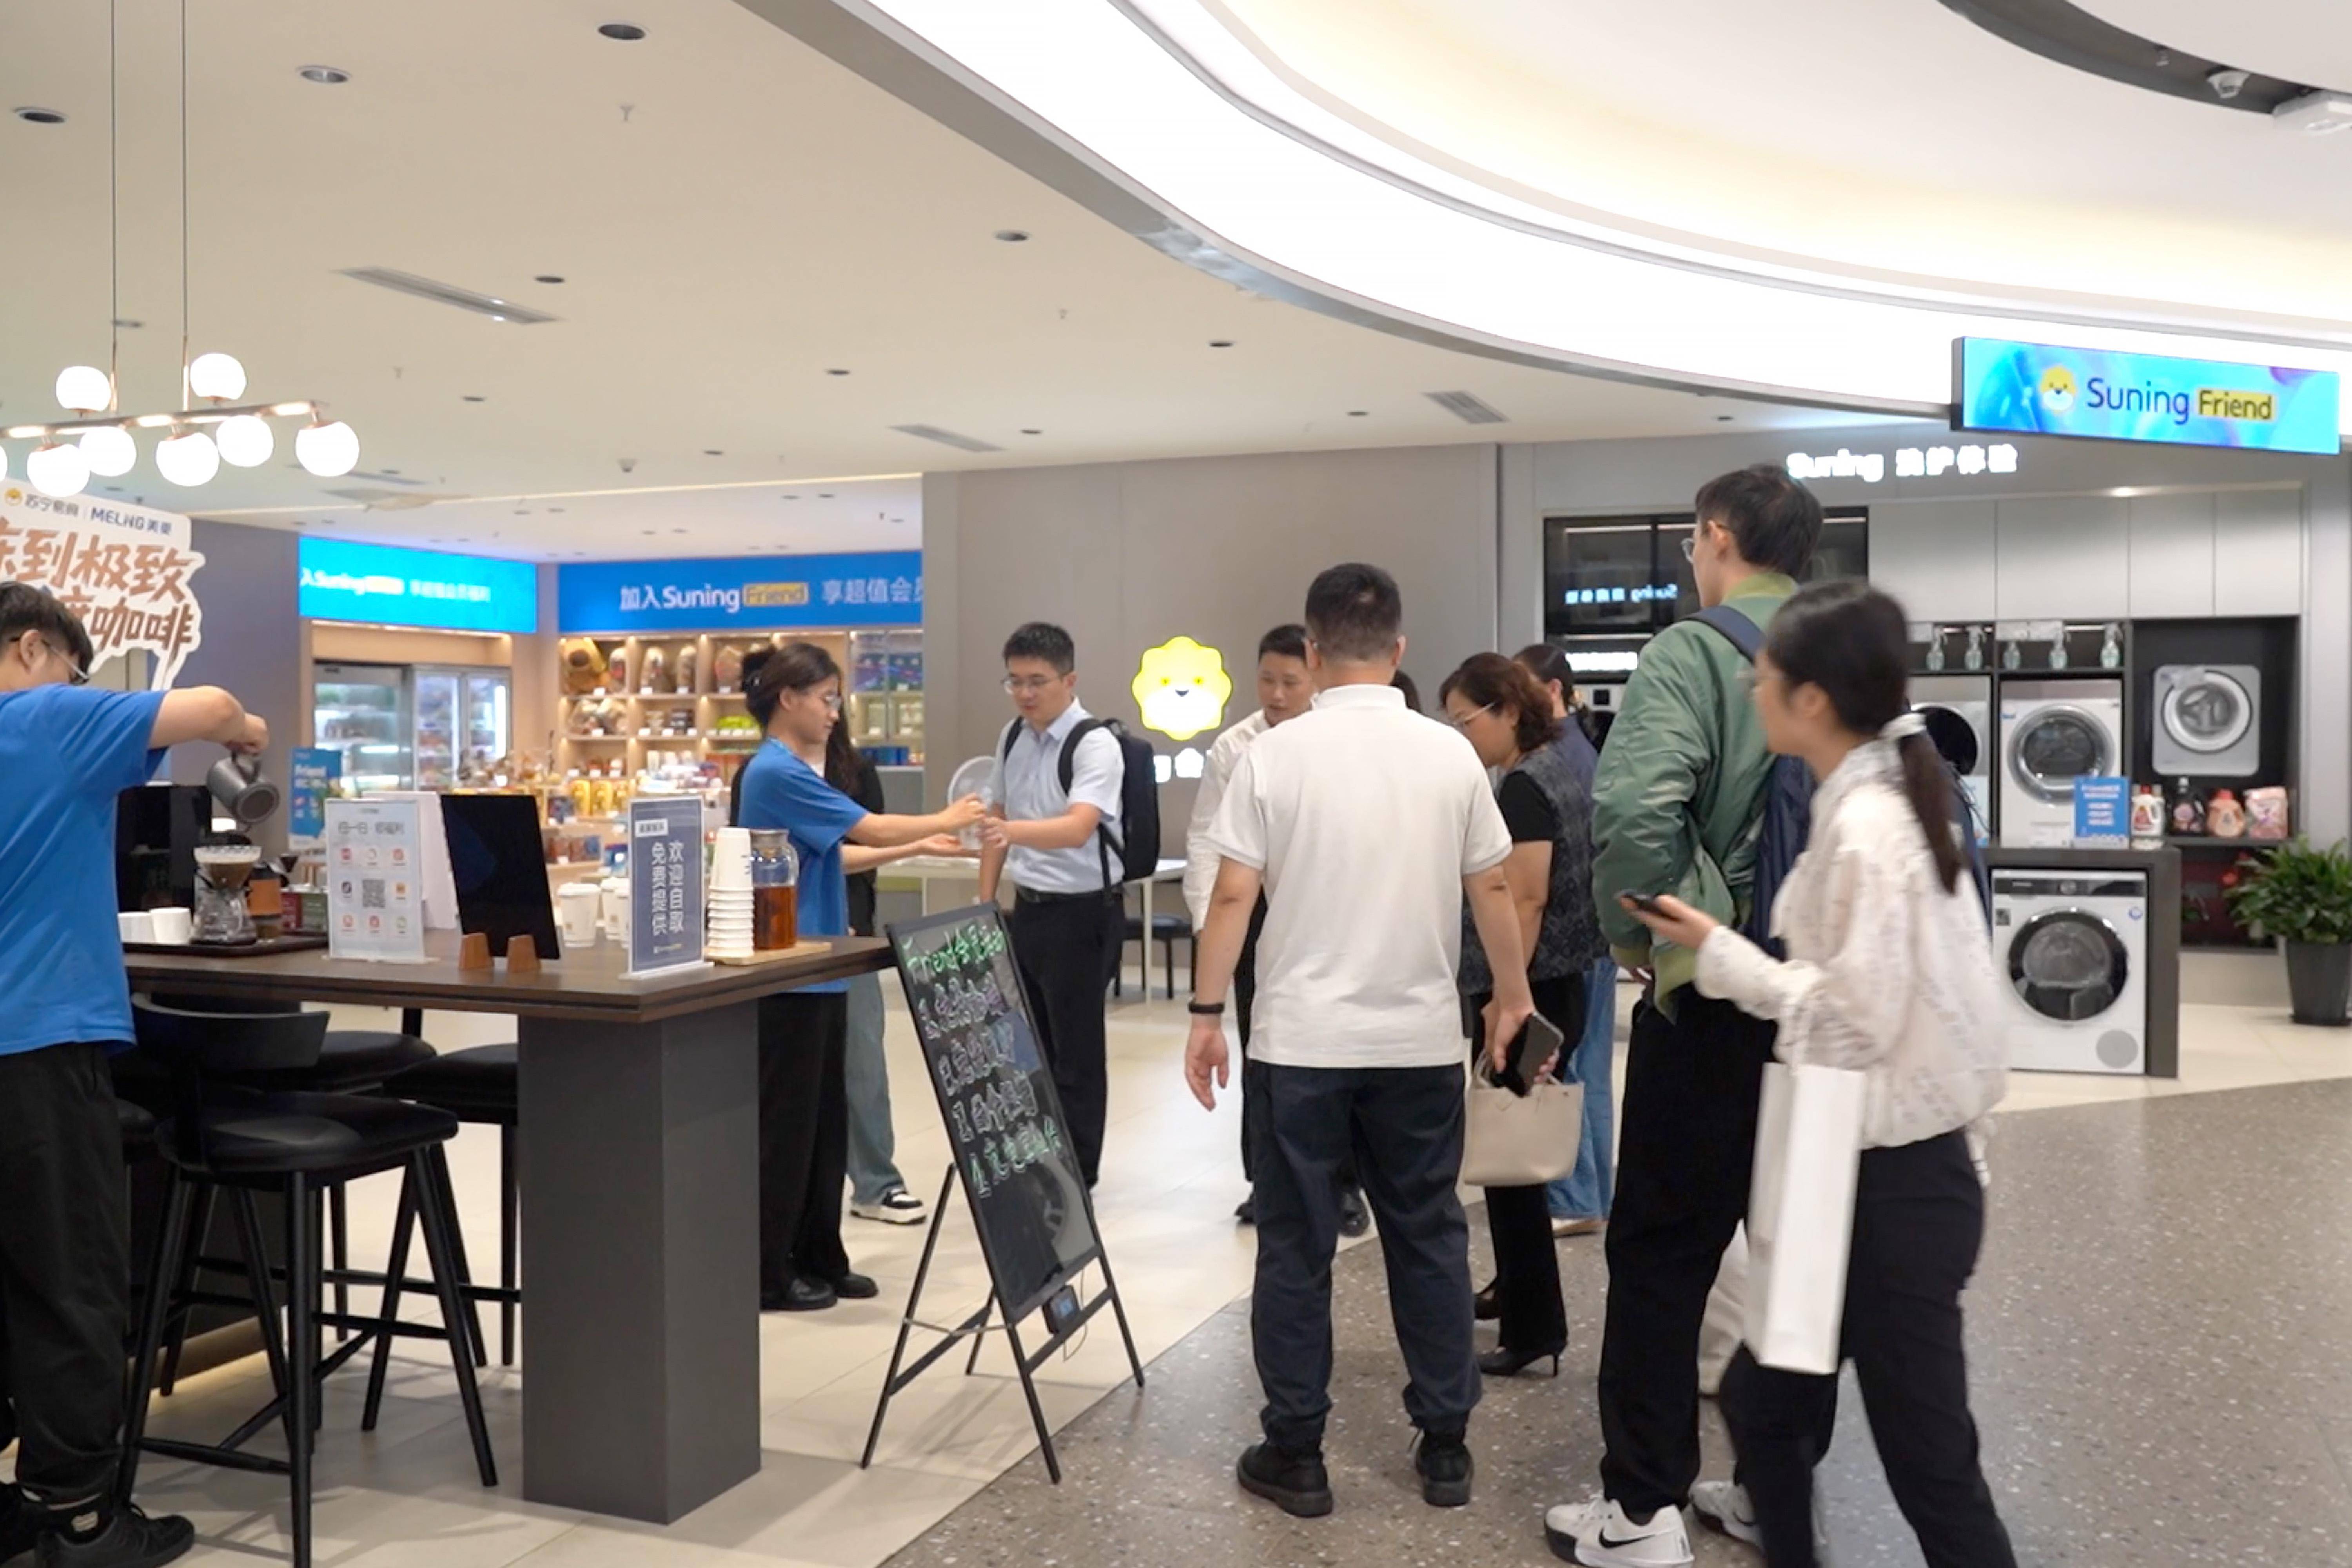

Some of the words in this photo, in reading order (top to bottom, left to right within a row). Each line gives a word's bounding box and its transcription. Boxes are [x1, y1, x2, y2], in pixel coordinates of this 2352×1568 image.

[2087, 377, 2190, 424] Suning
[2198, 390, 2272, 420] Friend
[662, 583, 740, 614] Suning
